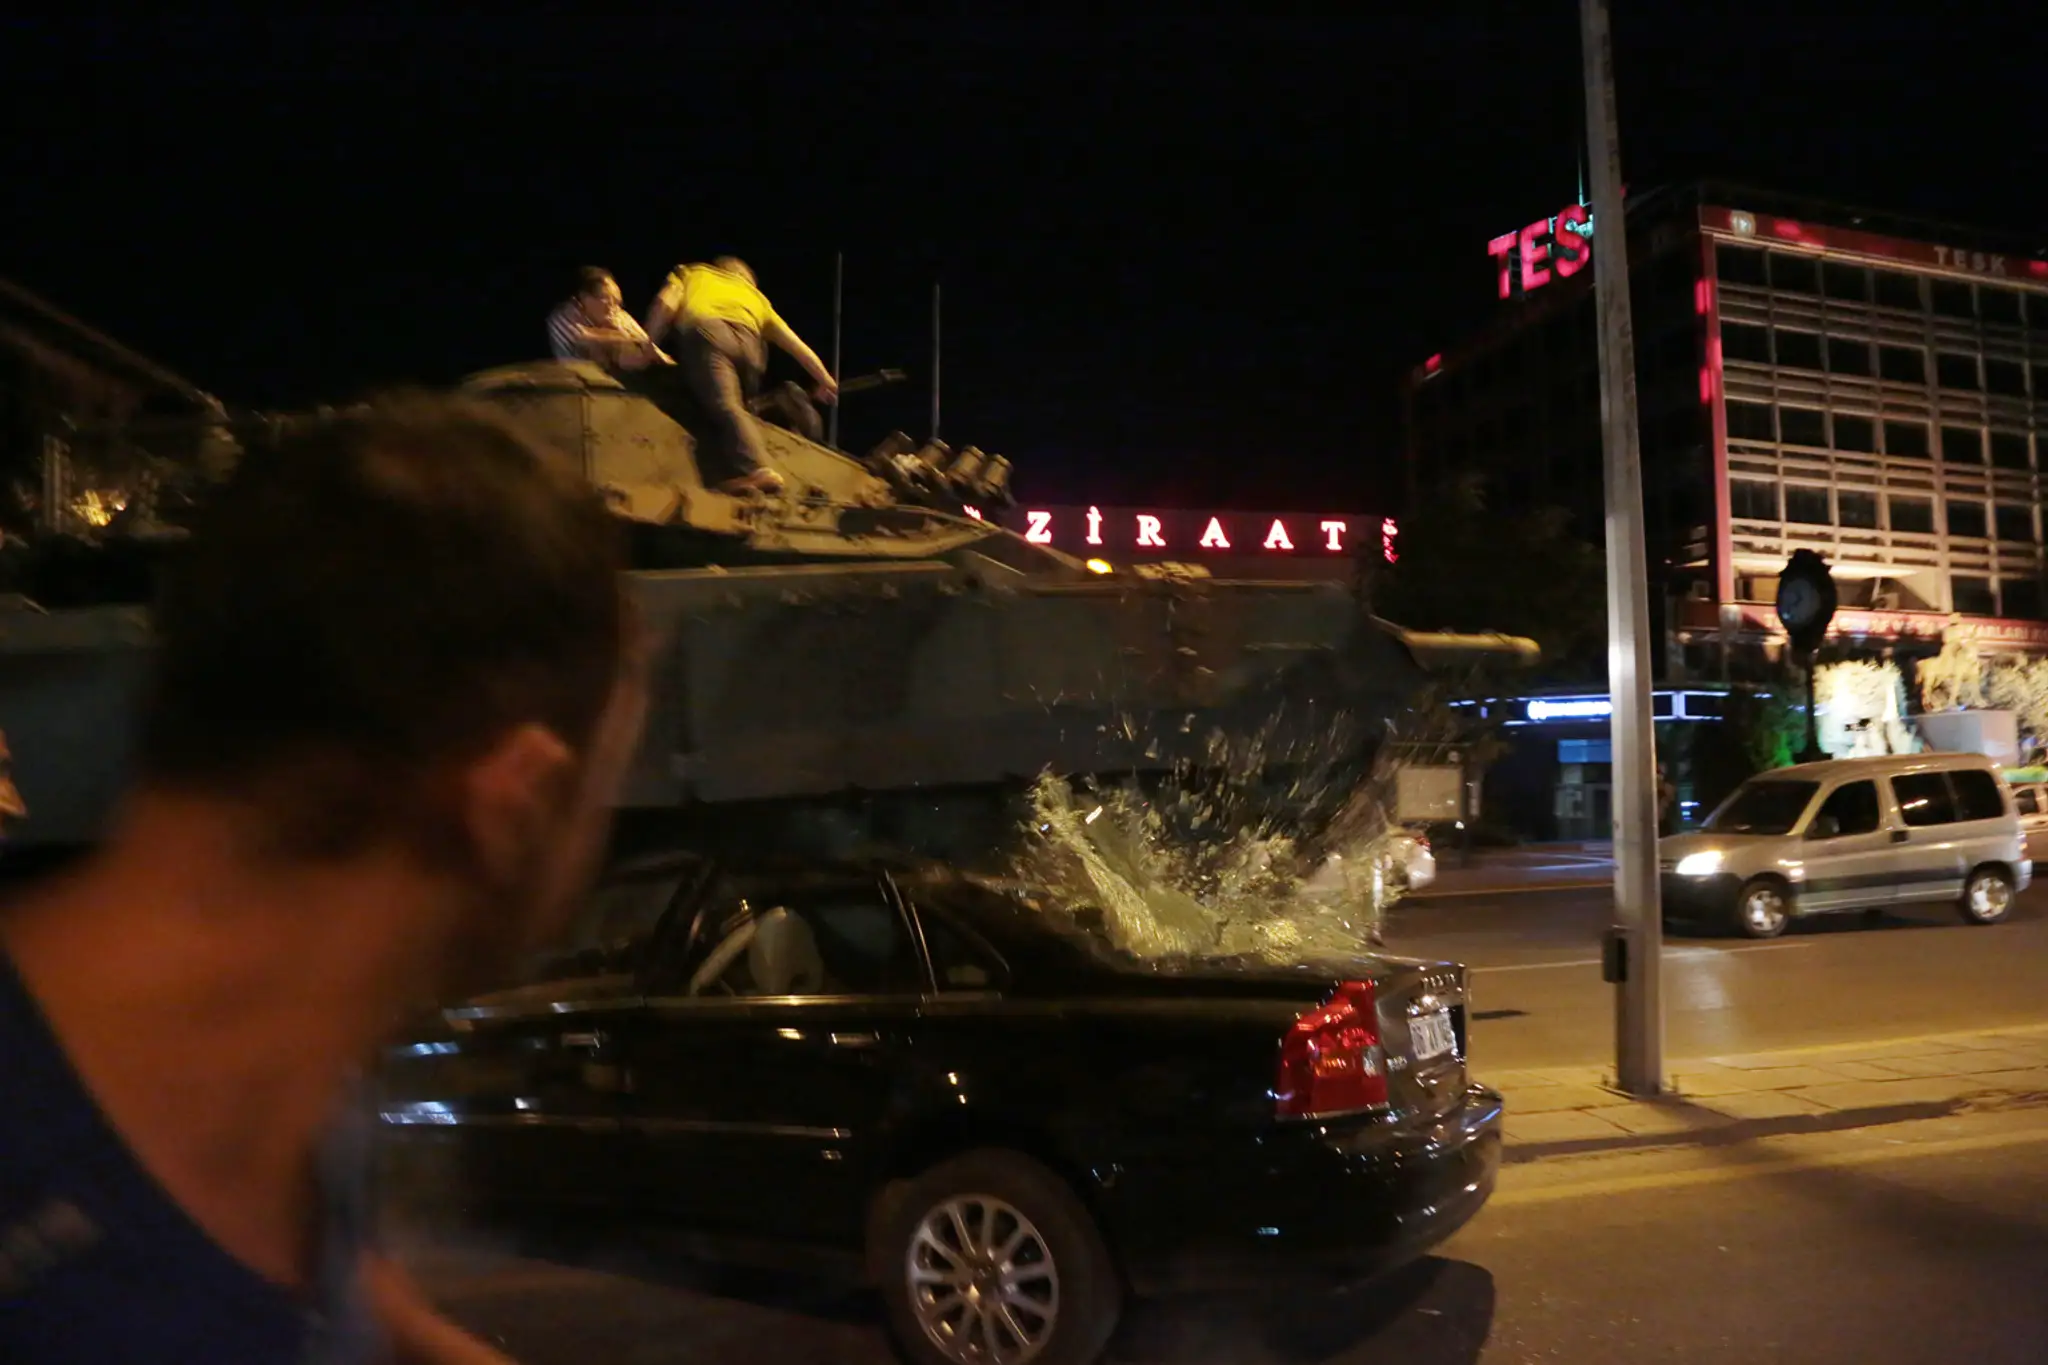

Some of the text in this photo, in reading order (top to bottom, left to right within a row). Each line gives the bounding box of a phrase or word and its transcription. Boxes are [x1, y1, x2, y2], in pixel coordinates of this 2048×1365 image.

[1487, 203, 1591, 299] TES
[1933, 245, 2007, 276] TESK
[1024, 505, 1347, 551] ZİRAAT
